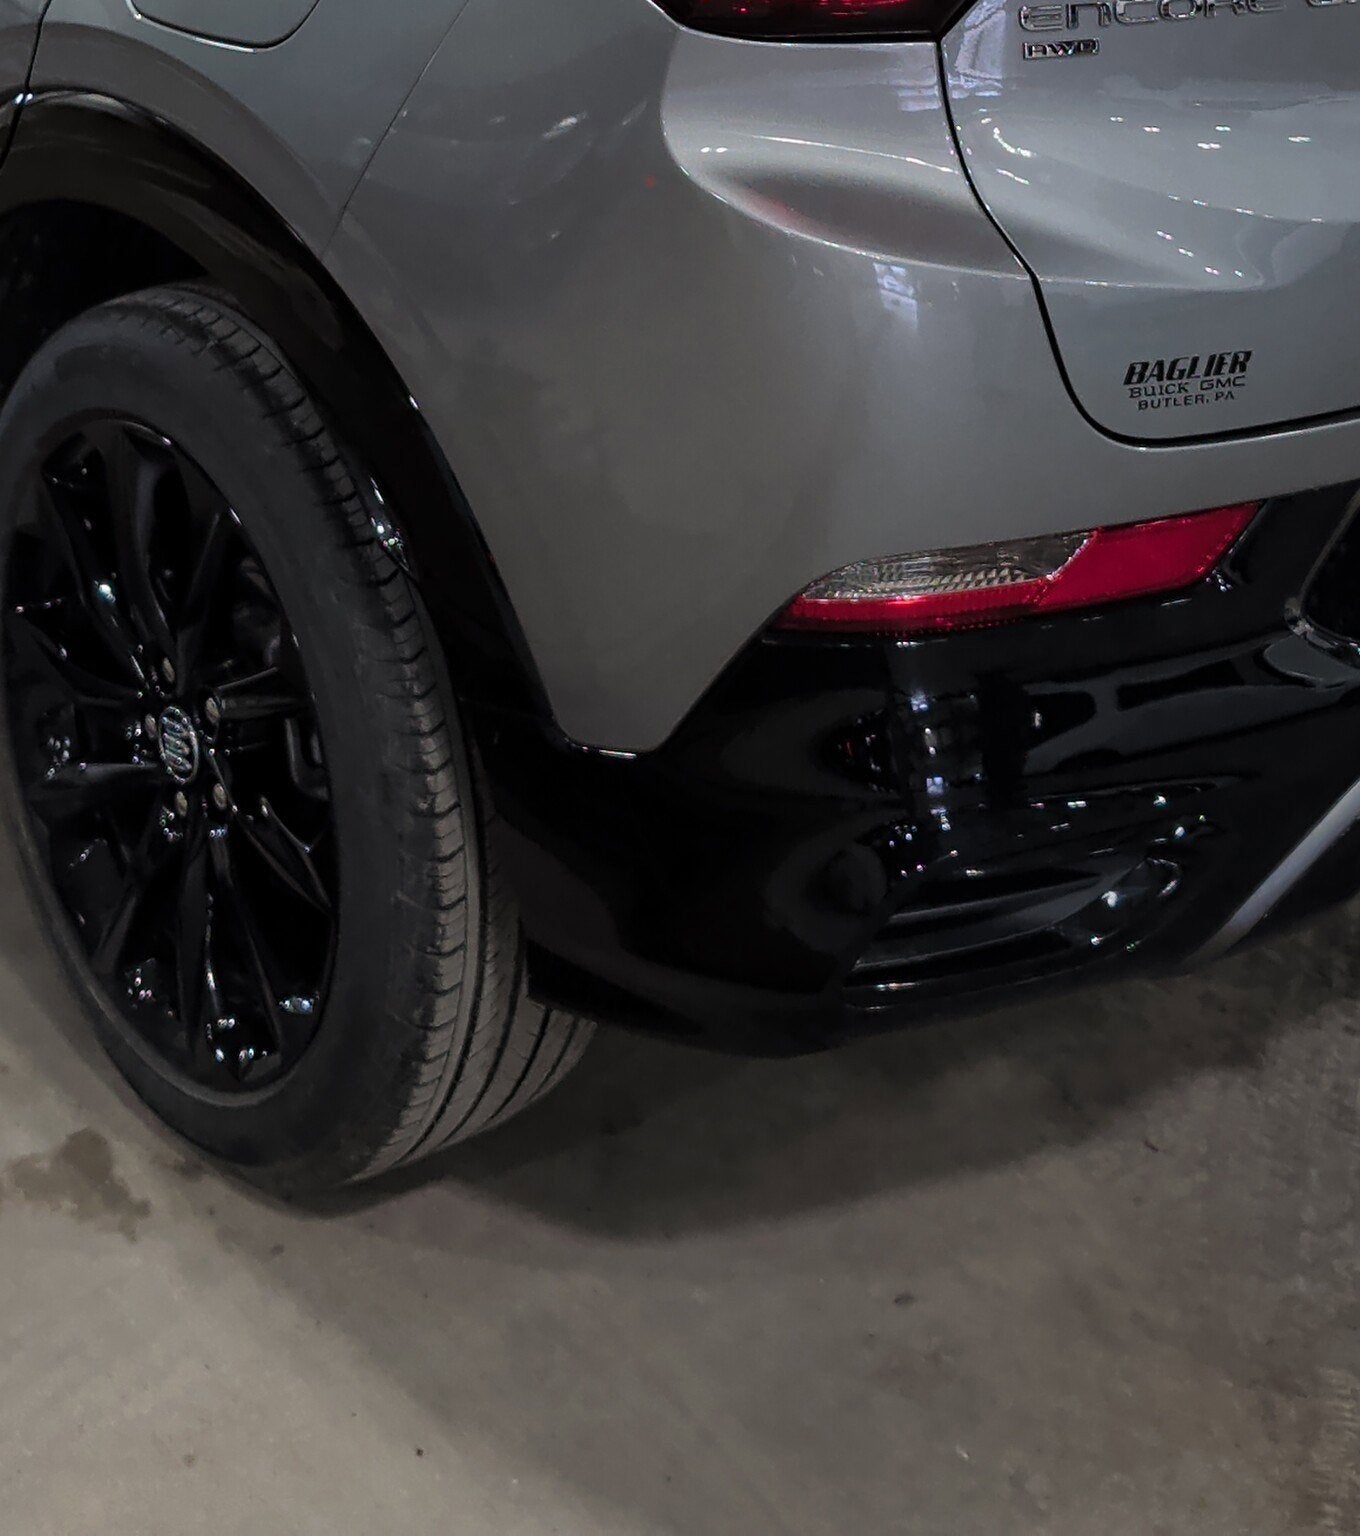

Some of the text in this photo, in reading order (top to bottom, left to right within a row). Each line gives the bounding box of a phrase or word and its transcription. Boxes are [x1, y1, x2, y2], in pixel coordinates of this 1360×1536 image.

[1023, 38, 1099, 61] AWD
[1123, 350, 1253, 386] BAGLIER
[1129, 375, 1246, 399] BUICK GMC
[1138, 390, 1236, 411] BUTLER, PA
